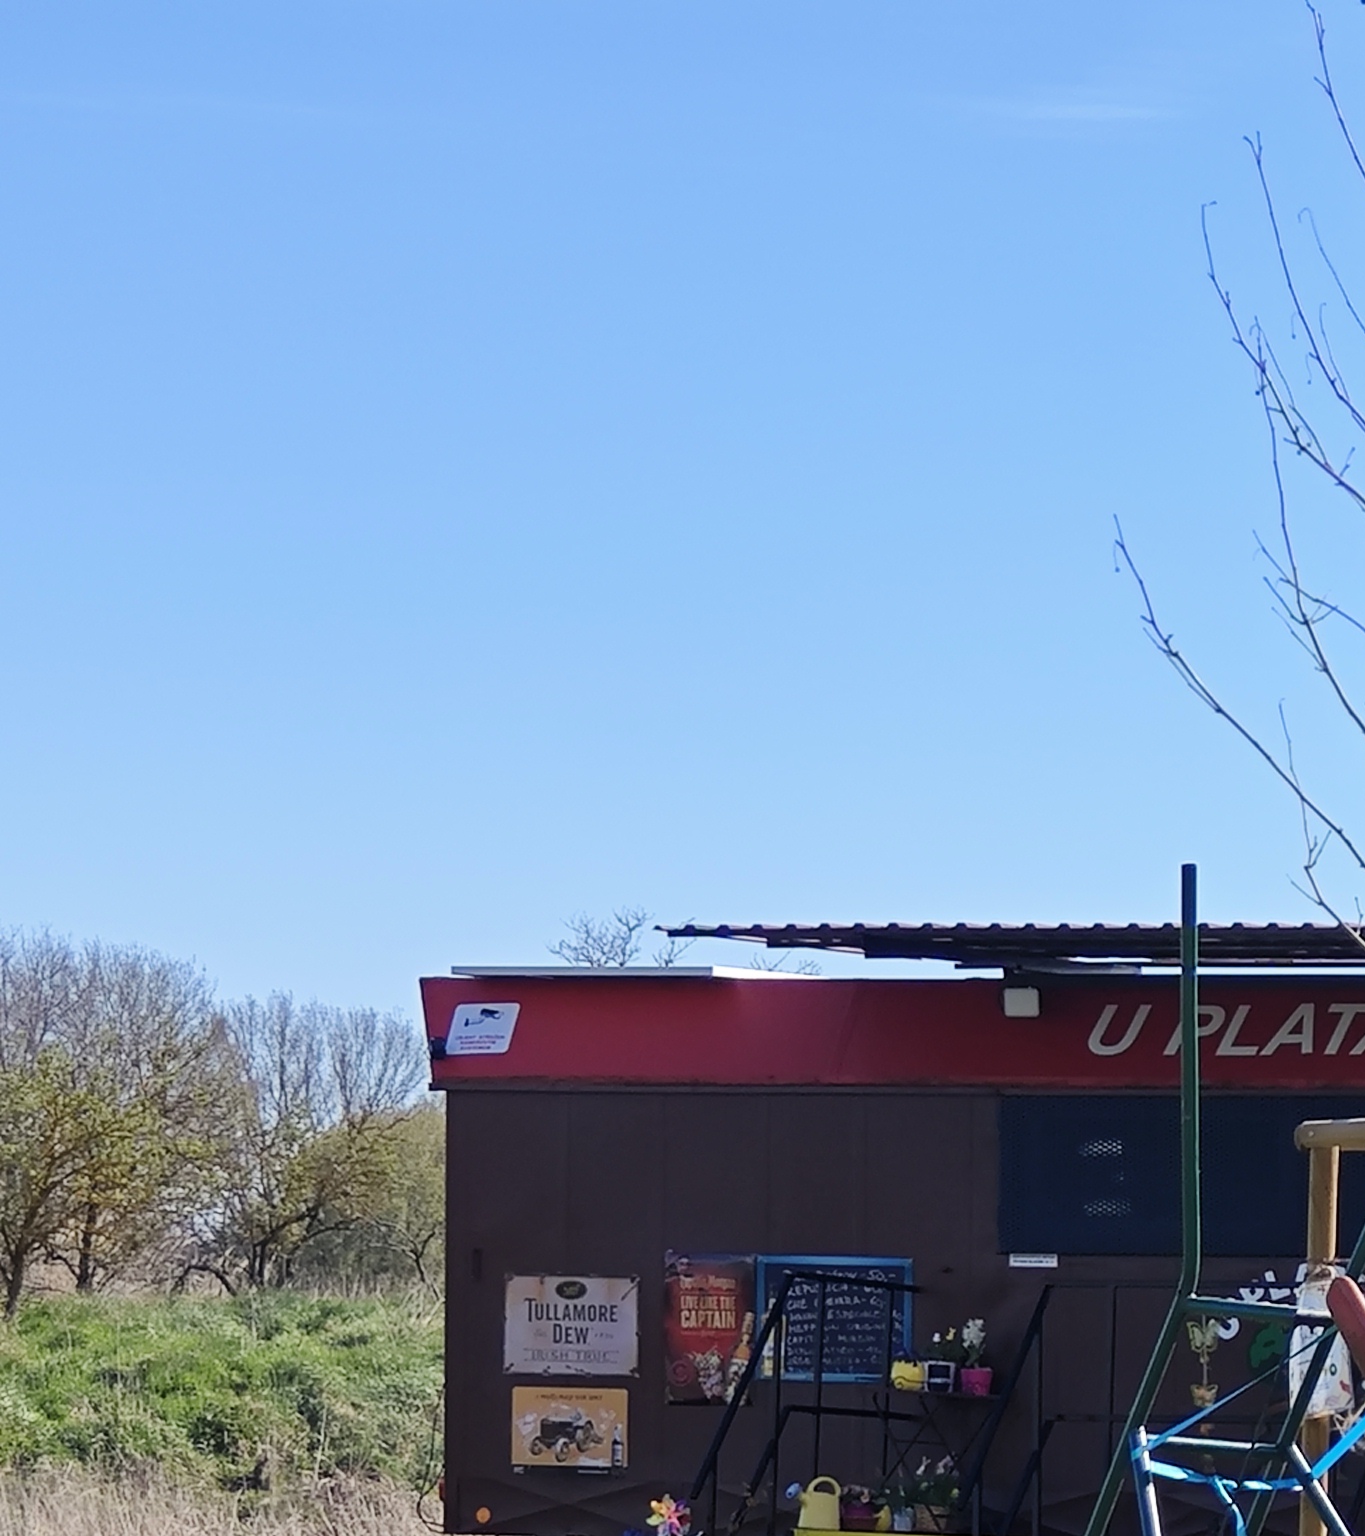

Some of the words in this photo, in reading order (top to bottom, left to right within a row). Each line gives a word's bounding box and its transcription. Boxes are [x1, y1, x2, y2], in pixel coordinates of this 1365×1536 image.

[1086, 1004, 1149, 1056] U
[523, 1297, 619, 1323] TULLAMORE
[680, 1310, 736, 1330] CAPTAIN
[552, 1323, 589, 1345] DEW
